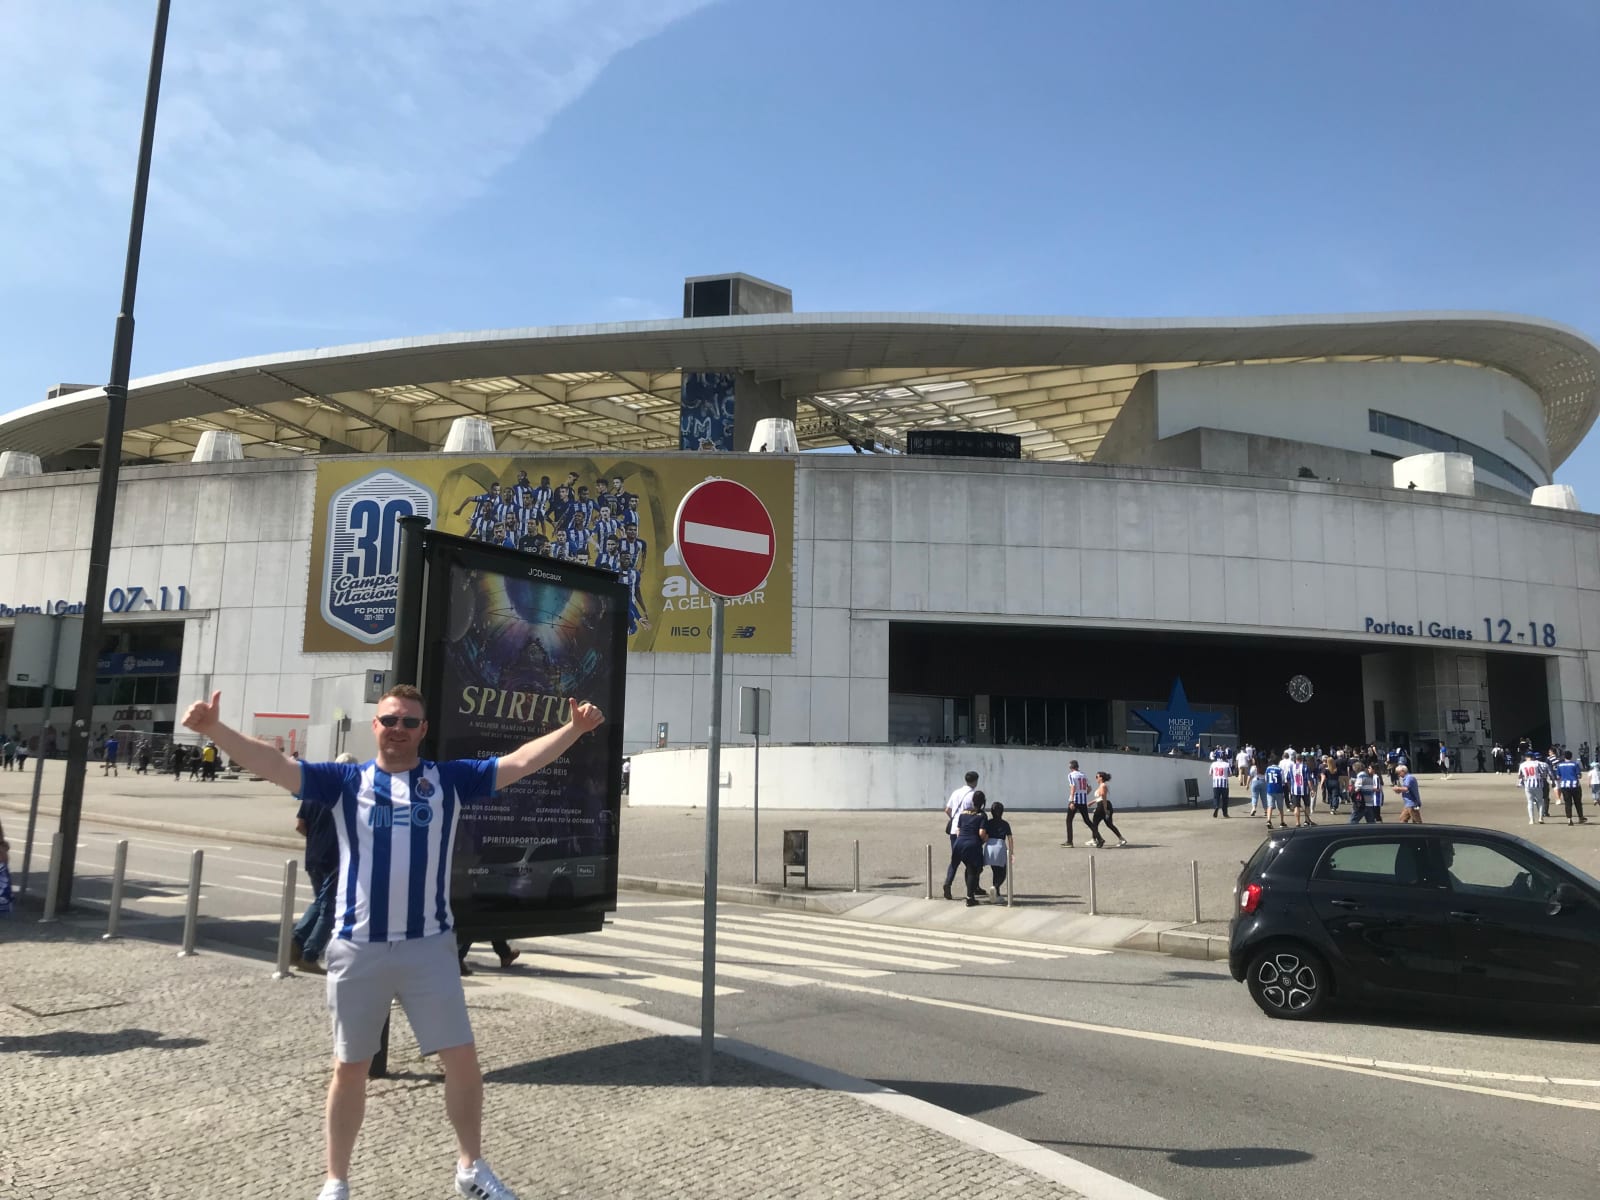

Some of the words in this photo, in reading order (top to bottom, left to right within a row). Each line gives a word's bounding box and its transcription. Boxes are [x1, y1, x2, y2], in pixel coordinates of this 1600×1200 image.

[108, 585, 187, 613] 07-11
[662, 600, 674, 612] A
[671, 626, 701, 637] MEO
[1365, 618, 1415, 635] Portas
[1428, 622, 1473, 641] Gates
[1483, 617, 1556, 648] 12-18
[459, 685, 592, 725] SPIRITU
[1168, 718, 1194, 726] MUSEU
[368, 802, 434, 827] MEO
